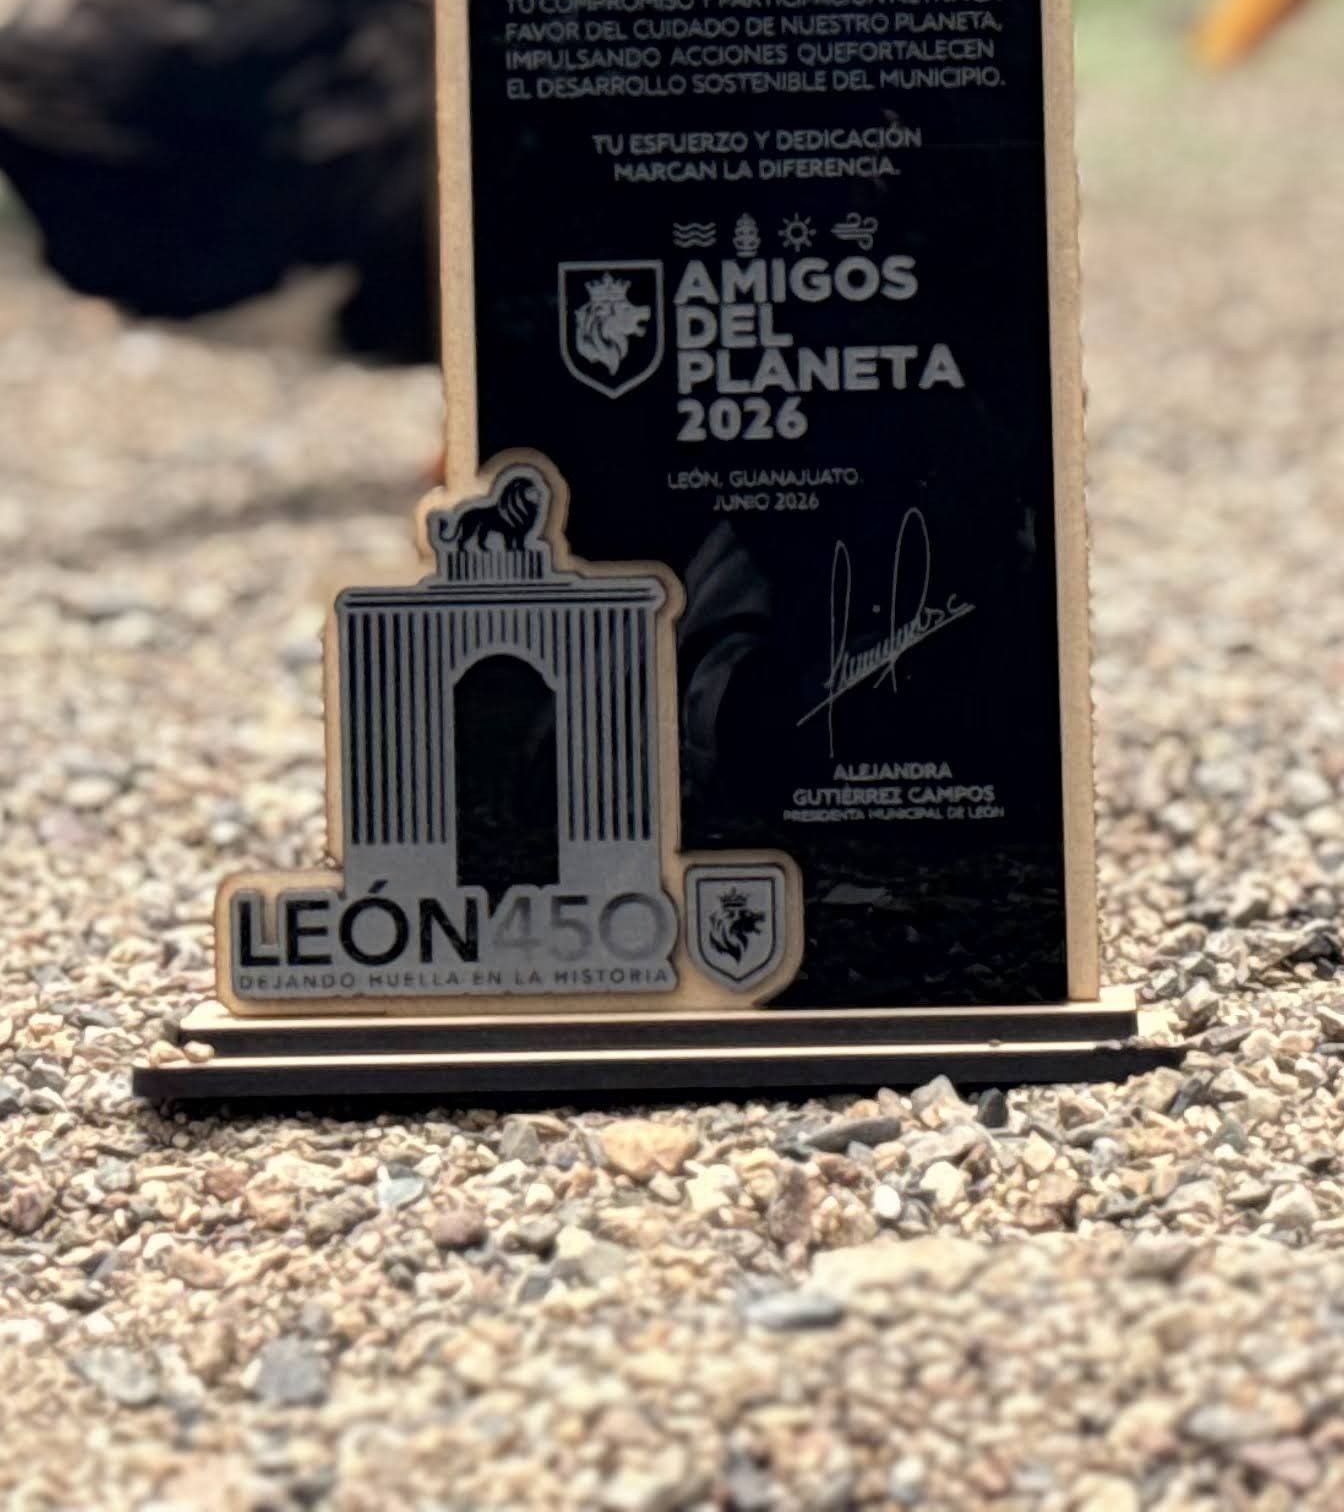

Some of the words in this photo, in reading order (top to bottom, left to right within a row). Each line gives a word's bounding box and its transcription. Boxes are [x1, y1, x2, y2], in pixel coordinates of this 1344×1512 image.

[505, 21, 580, 42] FAVOR
[585, 21, 627, 41] DEL
[633, 17, 739, 39] CUIDADO
[746, 16, 775, 36] DE
[782, 13, 889, 35] NUESTRO
[506, 47, 661, 70] IMPULSANDO
[671, 44, 788, 66] ACCIONES
[507, 78, 531, 100] EL
[537, 75, 686, 98] DESARROLLO
[692, 71, 827, 93] SOSTENIBLE
[833, 70, 874, 90] DEL
[880, 67, 1005, 89] MUNICIPIO.
[592, 134, 624, 155] TU
[630, 132, 748, 155] ESFUERZO
[756, 131, 770, 150] Y
[776, 122, 922, 150] DEDICACIÓN
[614, 160, 717, 182] MARCAN
[723, 160, 752, 180] LA
[760, 156, 900, 179] DIFERENCIA.
[674, 256, 918, 304] AMIGOS
[677, 304, 793, 350] DEL
[677, 344, 964, 394] PLANETA
[677, 398, 808, 441] 2026
[713, 494, 769, 511] JUNIO
[775, 492, 819, 510] 2026
[834, 762, 952, 781] ALEJANDRA
[793, 783, 903, 806] GUTIÉRREZ
[908, 785, 996, 803] CAMPOS
[240, 972, 355, 990] DEJANDO
[369, 972, 459, 987] HUELLA
[473, 971, 501, 986] EN
[515, 970, 542, 984] LA
[555, 968, 668, 984] HISTORIA
